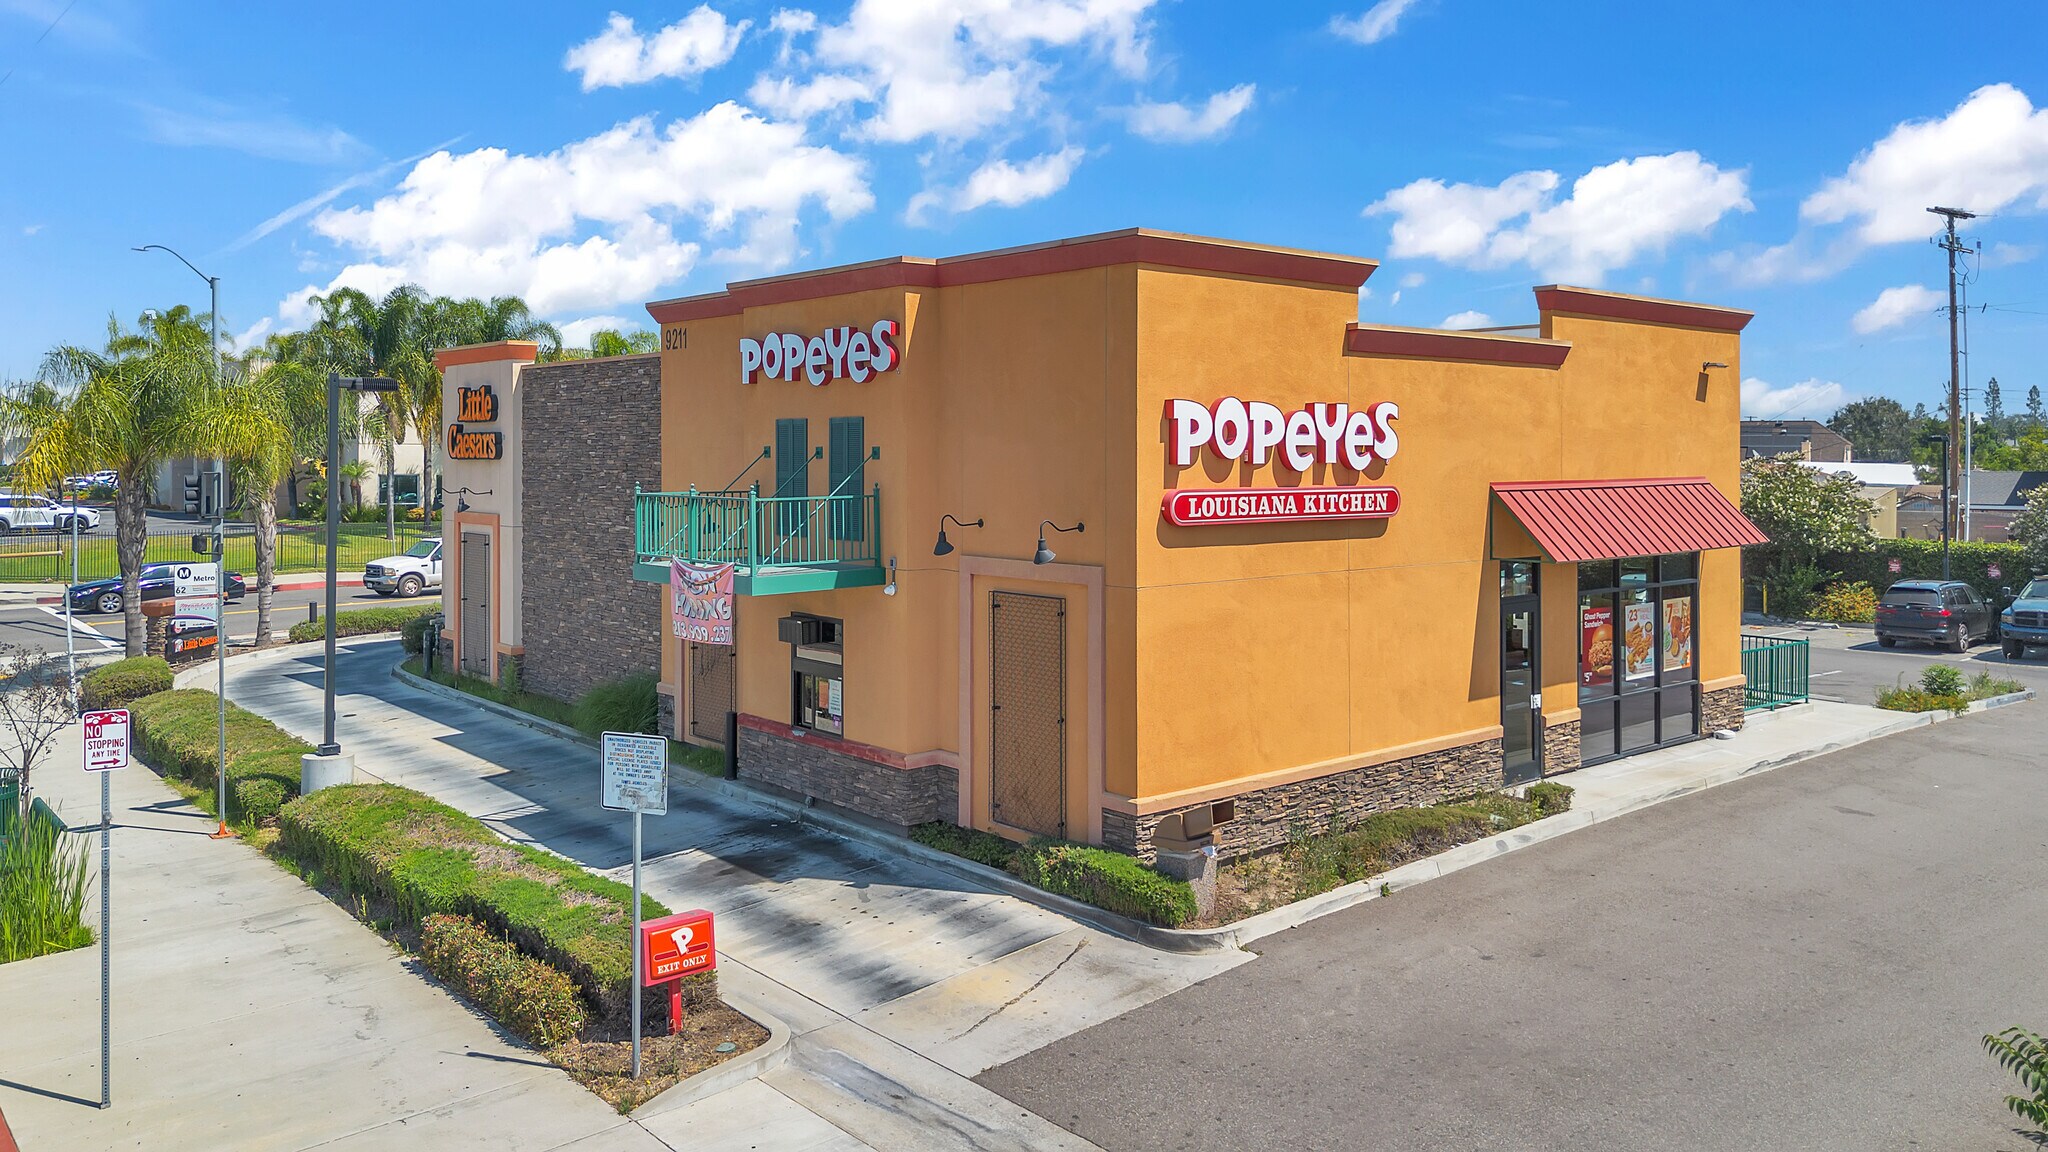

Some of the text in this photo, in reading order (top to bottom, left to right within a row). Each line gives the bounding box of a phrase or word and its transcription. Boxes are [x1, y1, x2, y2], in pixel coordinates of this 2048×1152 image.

[665, 327, 688, 350] 9211
[457, 385, 496, 422] Little
[448, 424, 502, 460] Caesars
[1188, 493, 1388, 518] LOUISIANA KITCHEN
[86, 725, 102, 738] NO
[88, 738, 124, 750] STOPPING
[658, 954, 706, 974] EXIT ONLY
